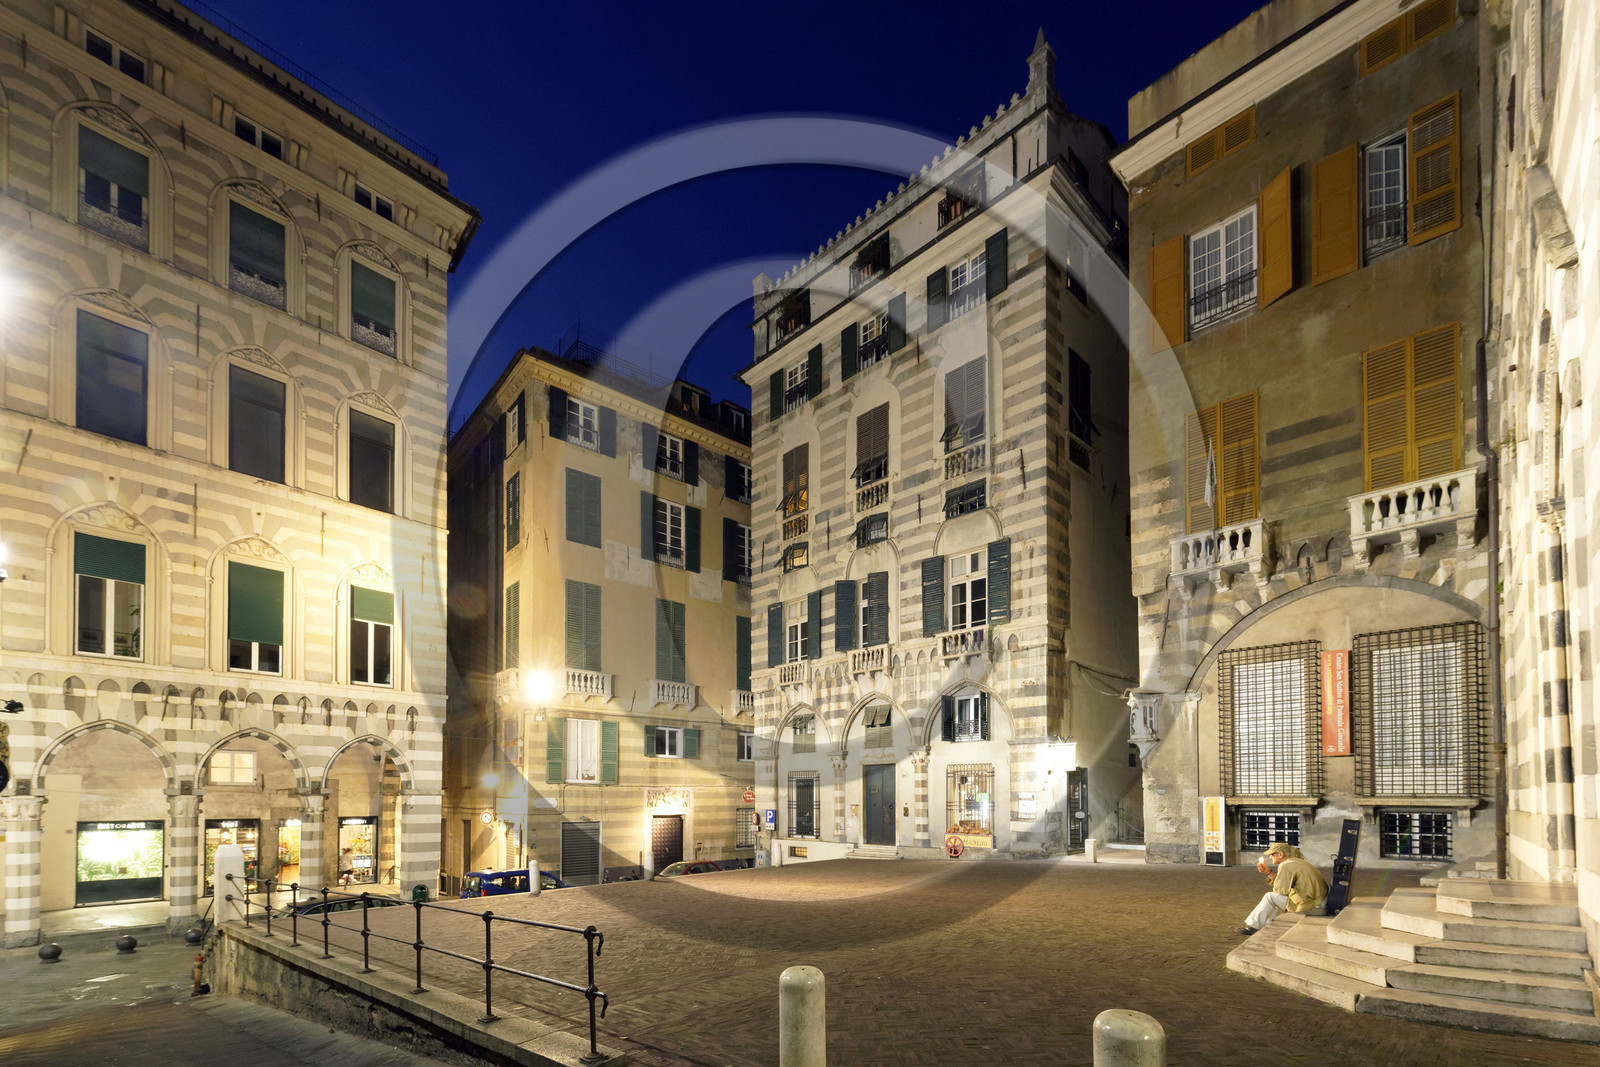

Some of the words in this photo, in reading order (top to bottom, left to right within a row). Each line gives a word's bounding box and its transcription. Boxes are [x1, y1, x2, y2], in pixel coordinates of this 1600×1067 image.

[1336, 681, 1344, 698] Matteo
[1337, 728, 1345, 752] Giovanile
[766, 810, 774, 822] P
[97, 822, 146, 830] RISTORANTE
